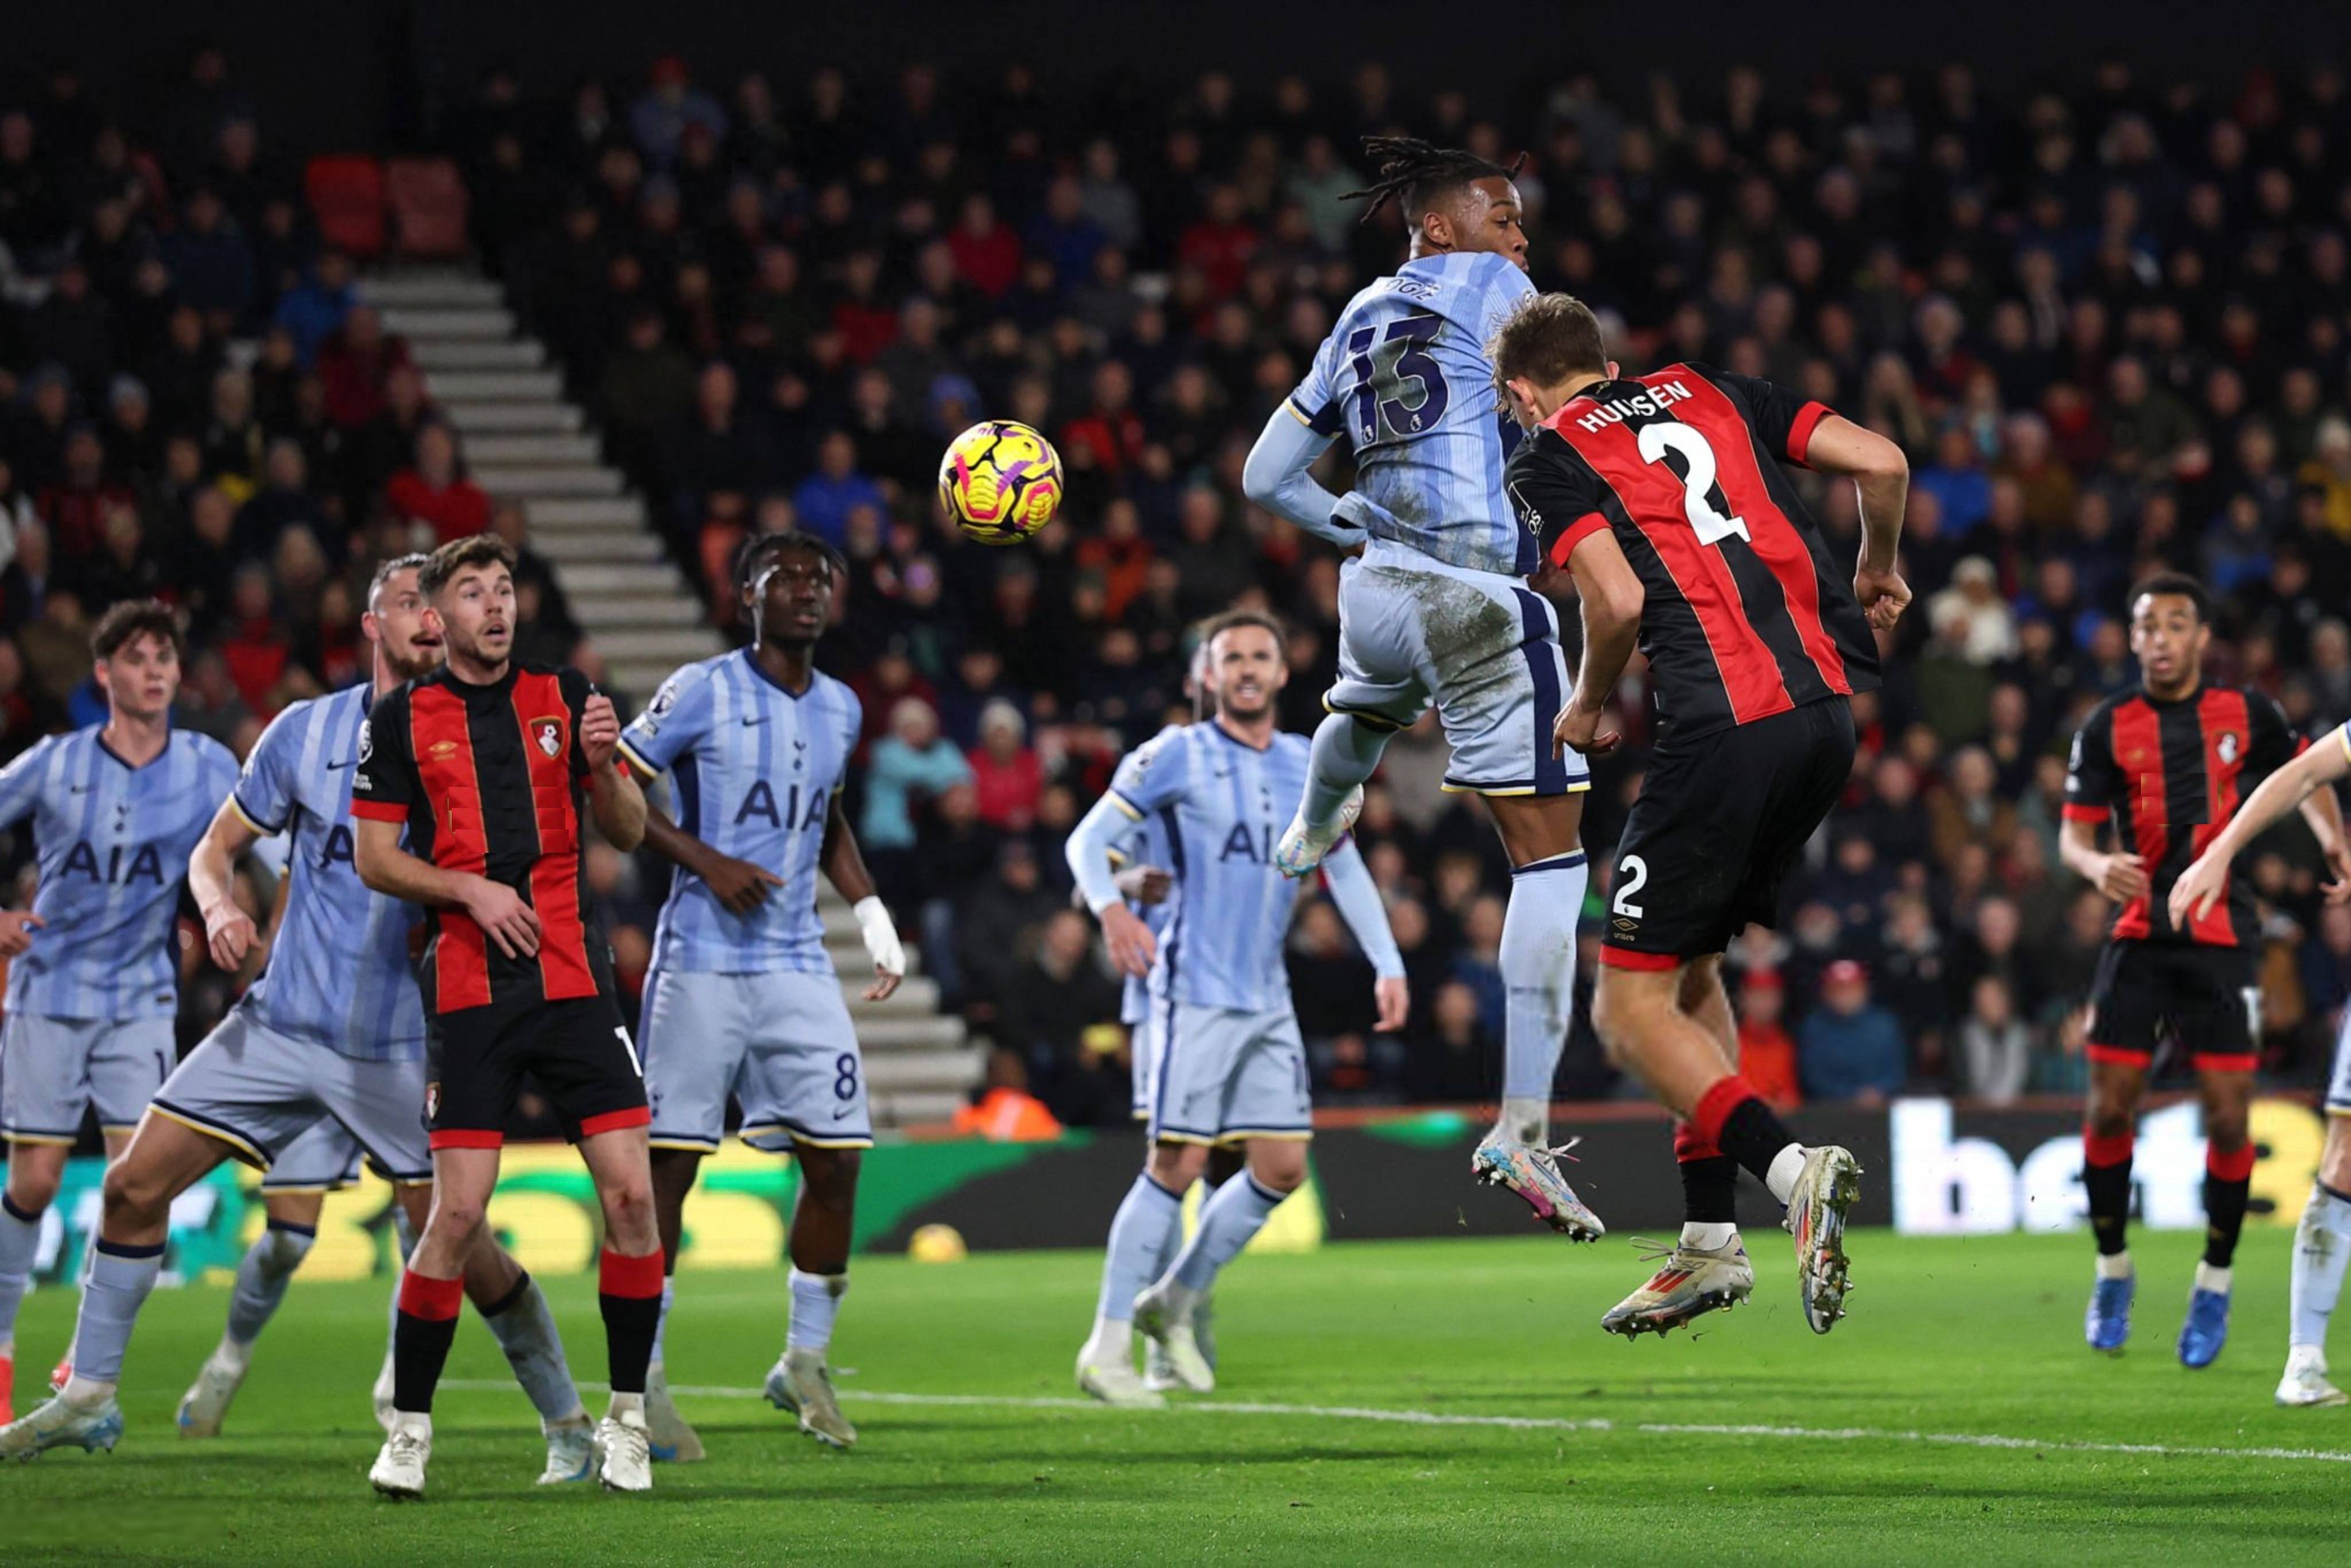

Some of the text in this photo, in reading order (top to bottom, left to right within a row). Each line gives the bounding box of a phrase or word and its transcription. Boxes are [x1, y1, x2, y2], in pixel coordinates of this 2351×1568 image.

[1348, 315, 1449, 448] 13
[1638, 422, 1752, 546] 2
[734, 778, 827, 832] AIA
[60, 839, 165, 886] AIA
[1219, 820, 1271, 864] AI
[1612, 854, 1647, 919] 2
[834, 1053, 857, 1101] 8
